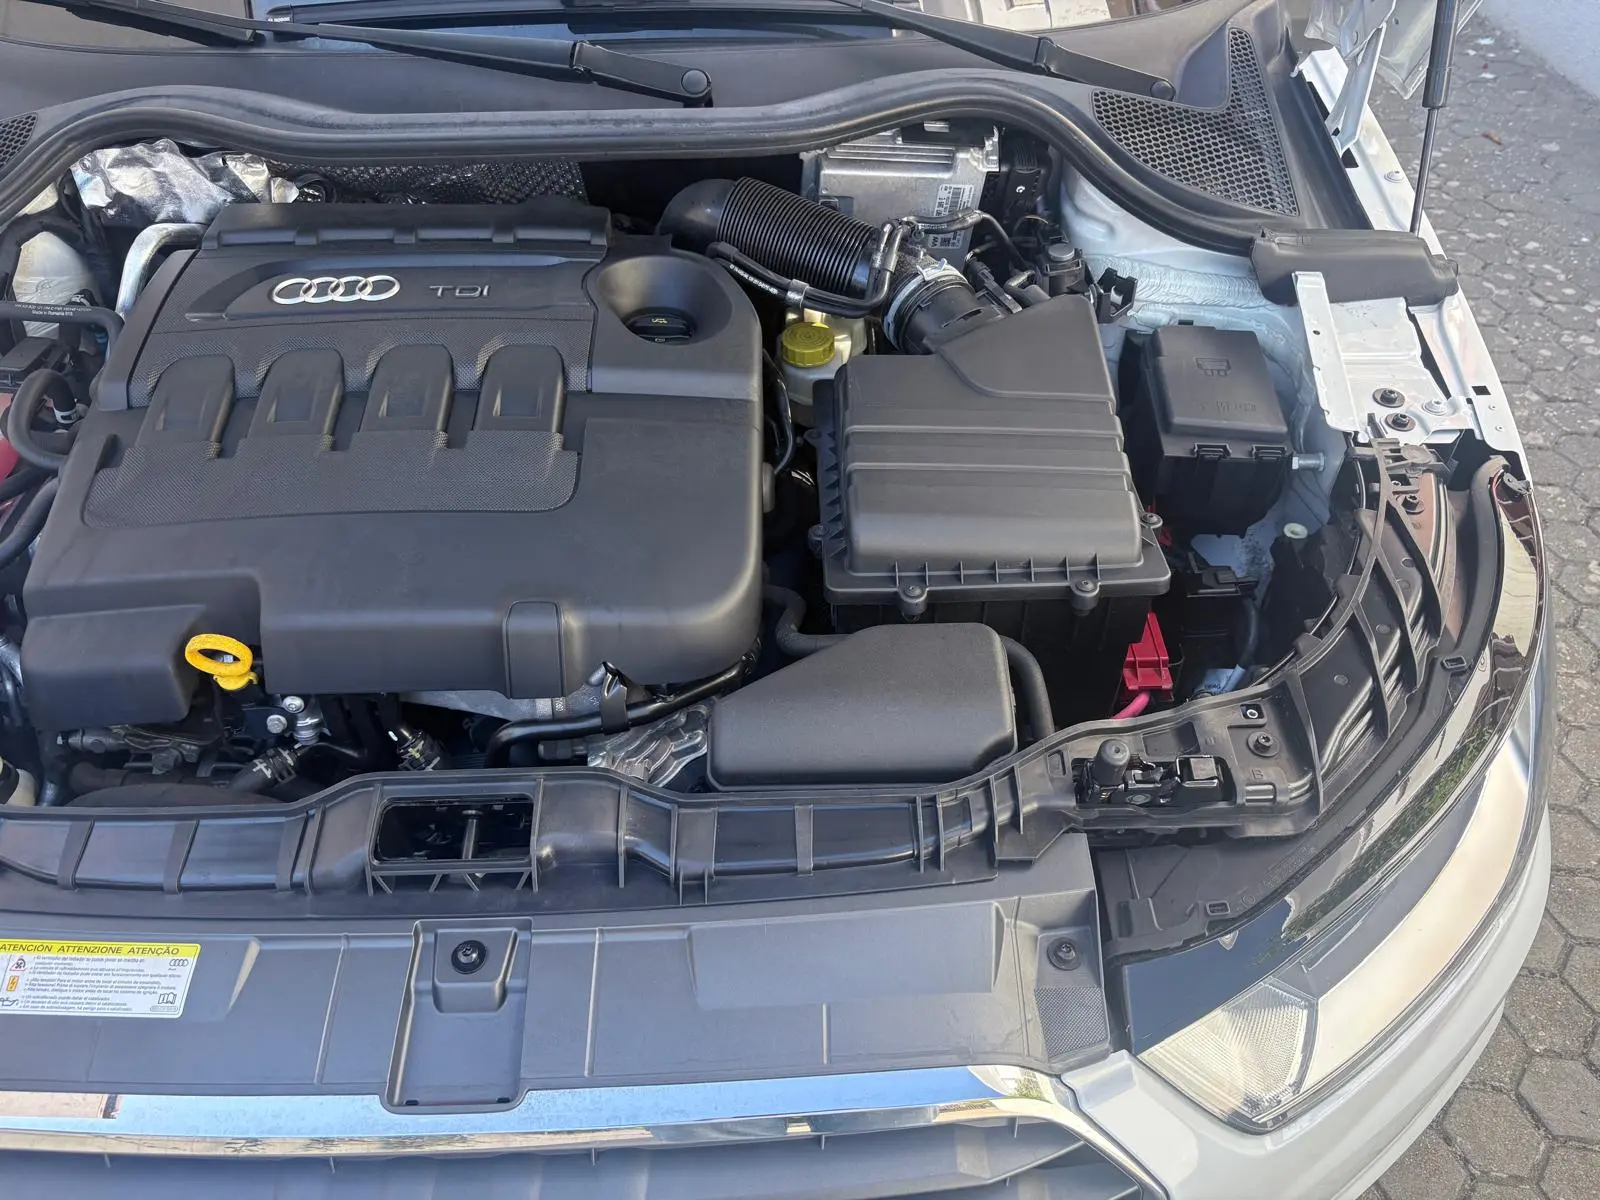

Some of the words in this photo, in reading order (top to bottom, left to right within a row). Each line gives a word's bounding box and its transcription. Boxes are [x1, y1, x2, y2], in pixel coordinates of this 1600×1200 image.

[429, 284, 490, 298] TDI
[0, 943, 53, 952] ATENCIÓN
[57, 945, 123, 954] ATTENZIONE
[127, 946, 180, 956] ATENÇÃO
